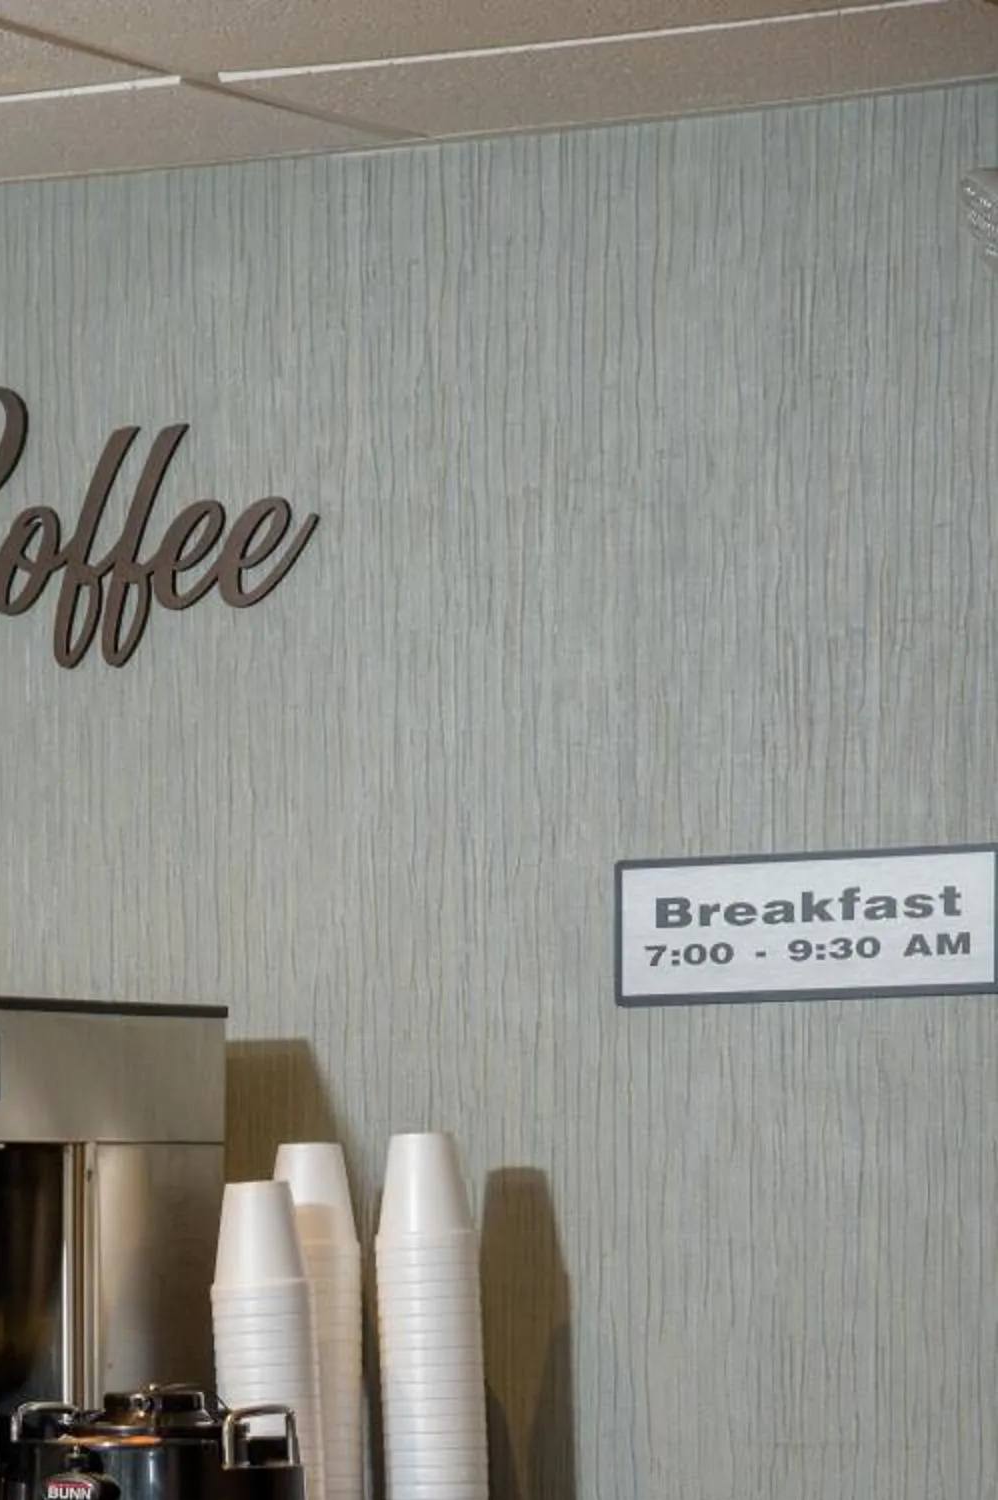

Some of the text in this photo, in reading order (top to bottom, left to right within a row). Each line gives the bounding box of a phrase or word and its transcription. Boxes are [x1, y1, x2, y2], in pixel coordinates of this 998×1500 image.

[655, 885, 963, 929] Breakfast
[644, 942, 735, 967] 7:00
[787, 936, 882, 962] 9:30
[903, 931, 972, 957] AM
[47, 1485, 91, 1500] BUNN
